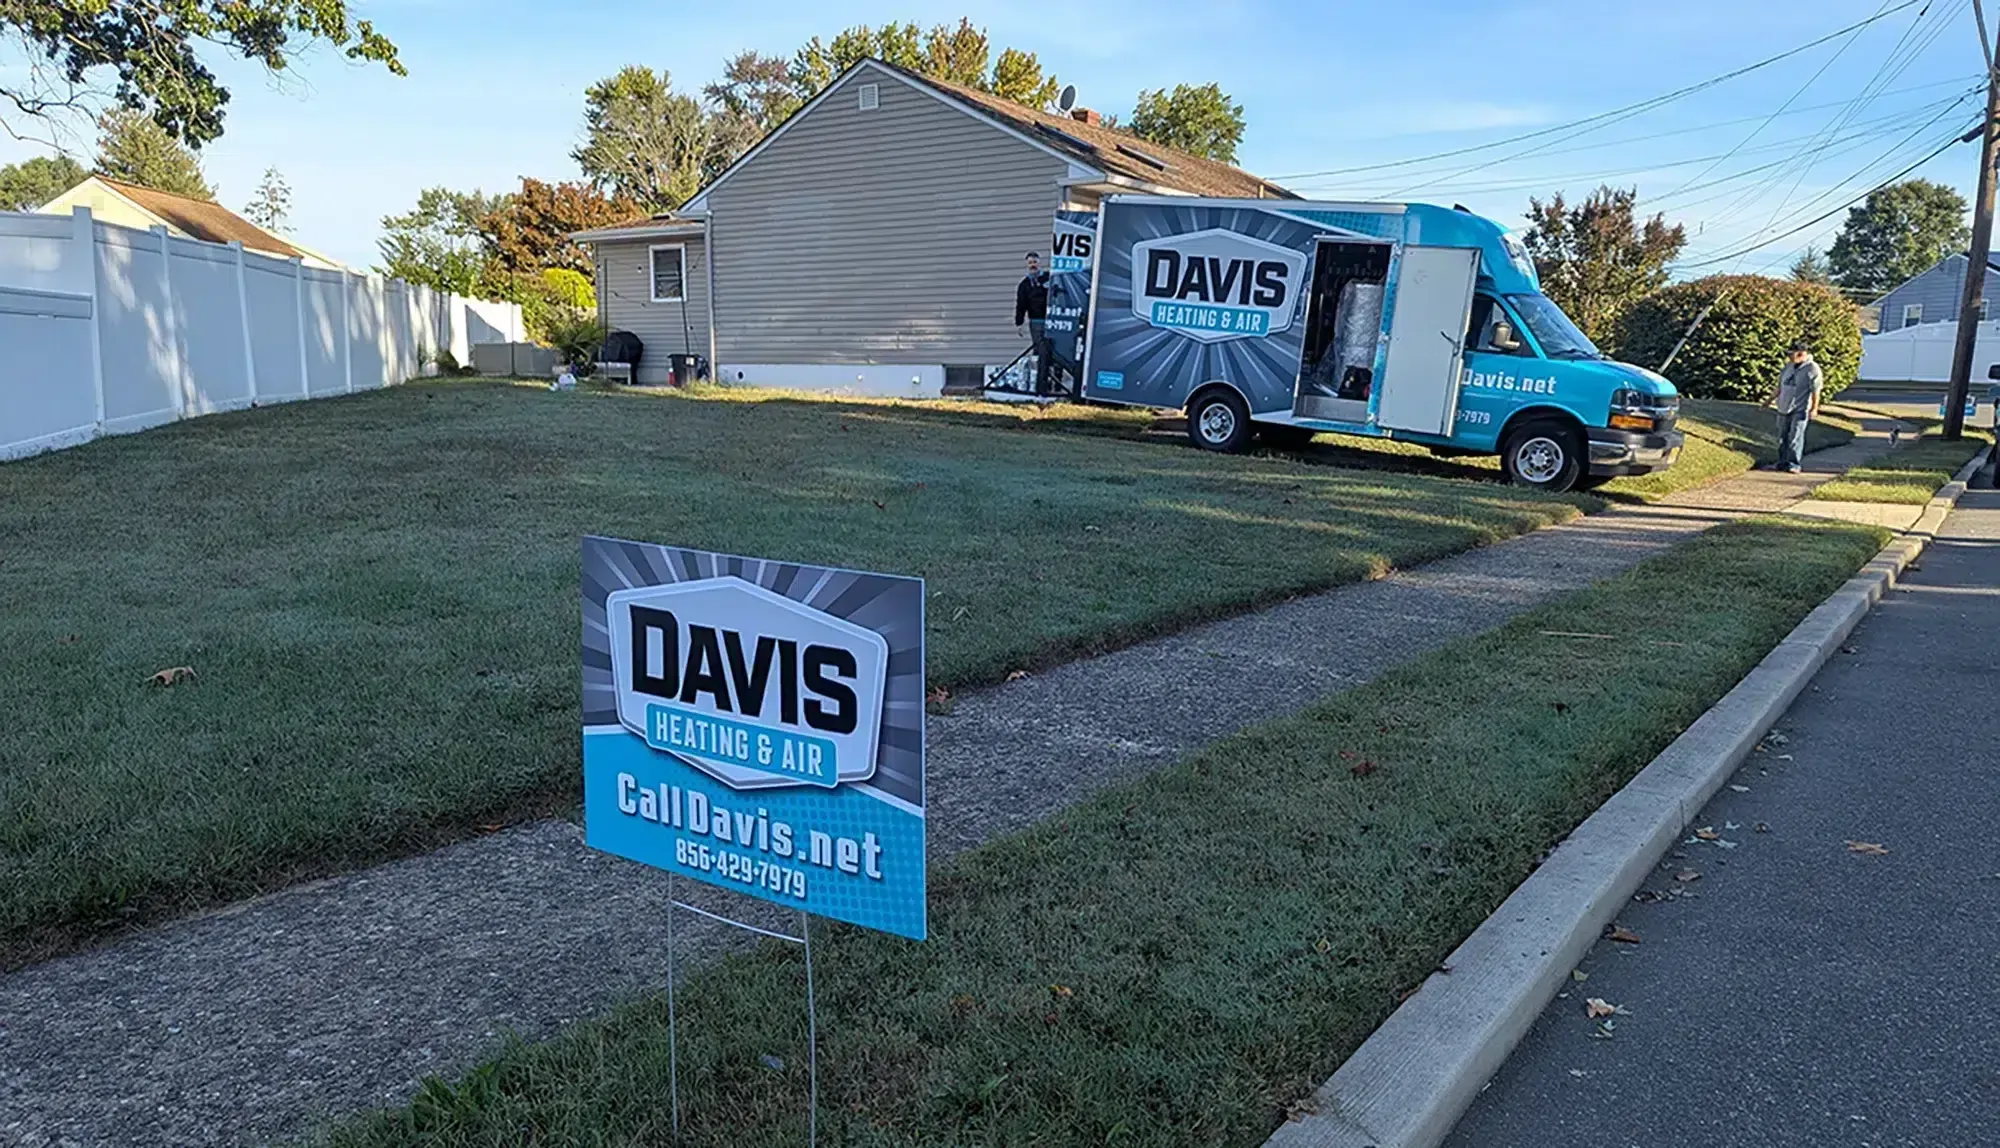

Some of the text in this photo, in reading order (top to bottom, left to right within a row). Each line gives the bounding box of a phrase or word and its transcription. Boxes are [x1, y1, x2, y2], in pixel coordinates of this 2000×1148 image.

[1145, 249, 1288, 307] DAVIS
[1157, 305, 1261, 332] HEATING & AIR
[1461, 368, 1557, 394] Davis.net
[628, 604, 858, 735] DAVIS
[655, 711, 823, 777] HEATING & AIR
[616, 771, 883, 880] CallDavis.net
